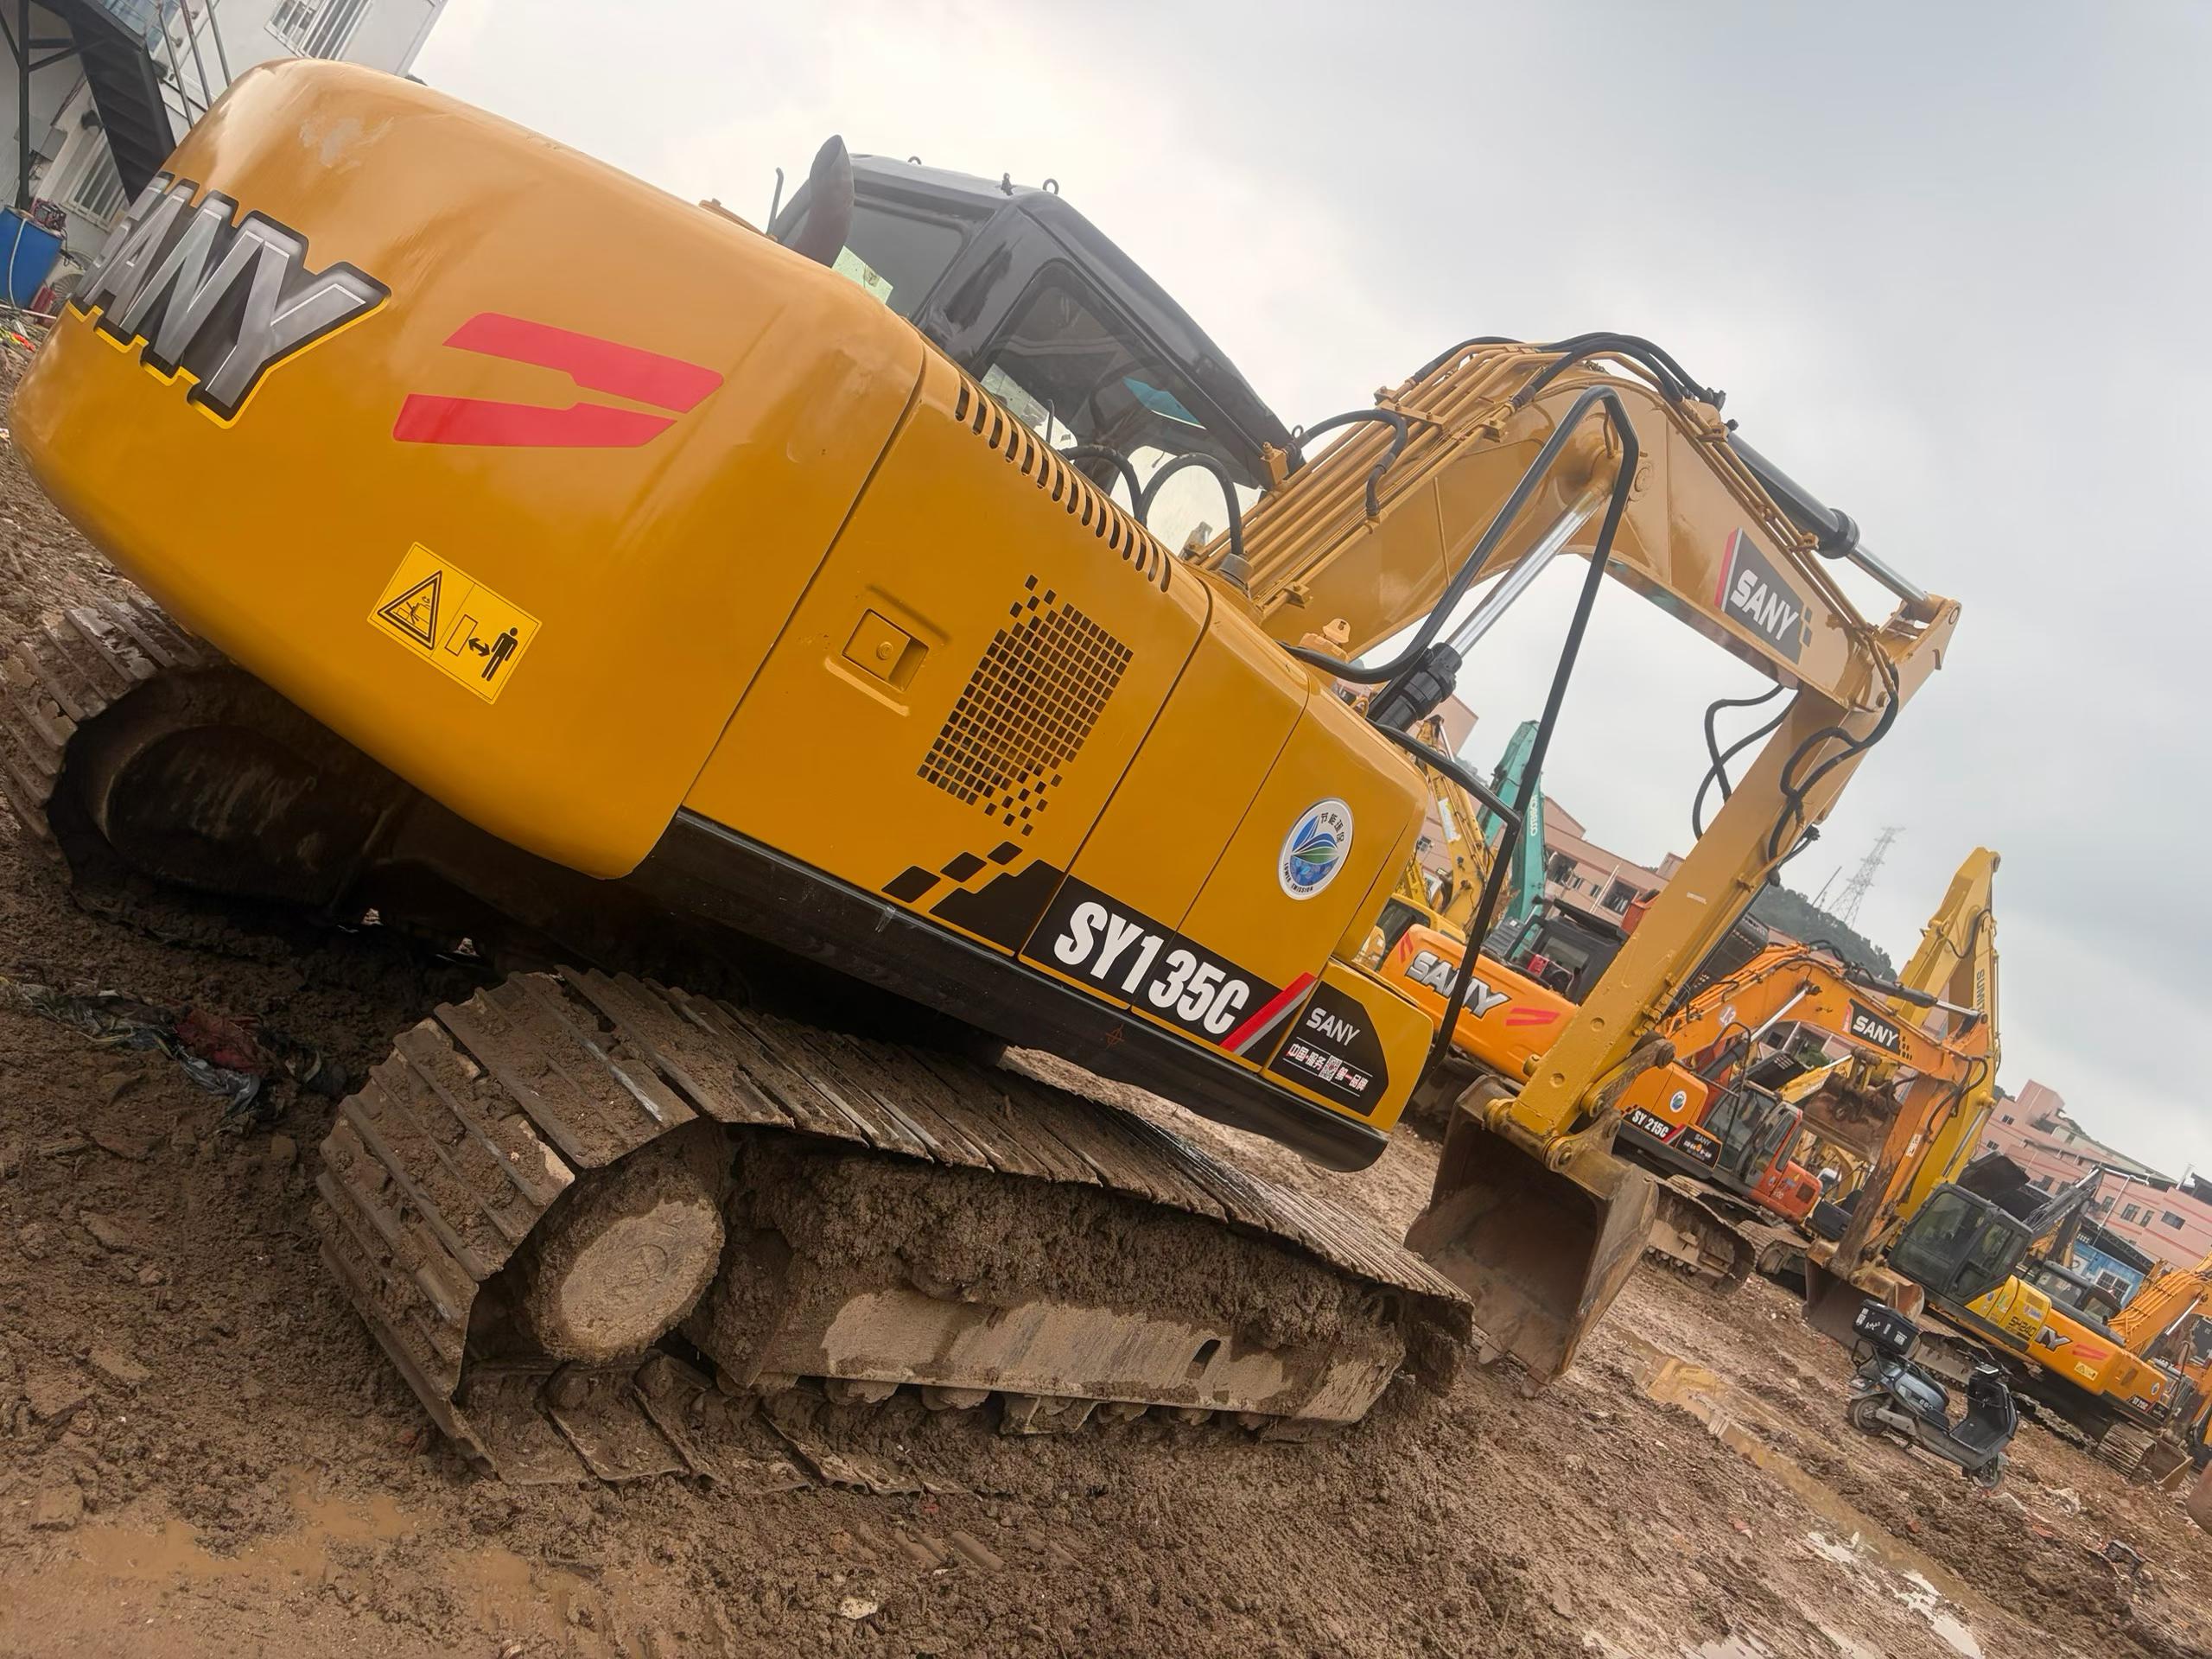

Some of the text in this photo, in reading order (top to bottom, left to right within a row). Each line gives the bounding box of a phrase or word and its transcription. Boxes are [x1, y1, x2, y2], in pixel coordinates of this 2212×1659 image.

[1730, 569, 1799, 640] SANY
[1320, 812, 1344, 843] 节能环保
[1291, 883, 1314, 893] EMISSION
[1054, 901, 1250, 1035] SY135C
[1306, 1007, 1361, 1046] SANY
[1853, 1015, 1898, 1047] SANY
